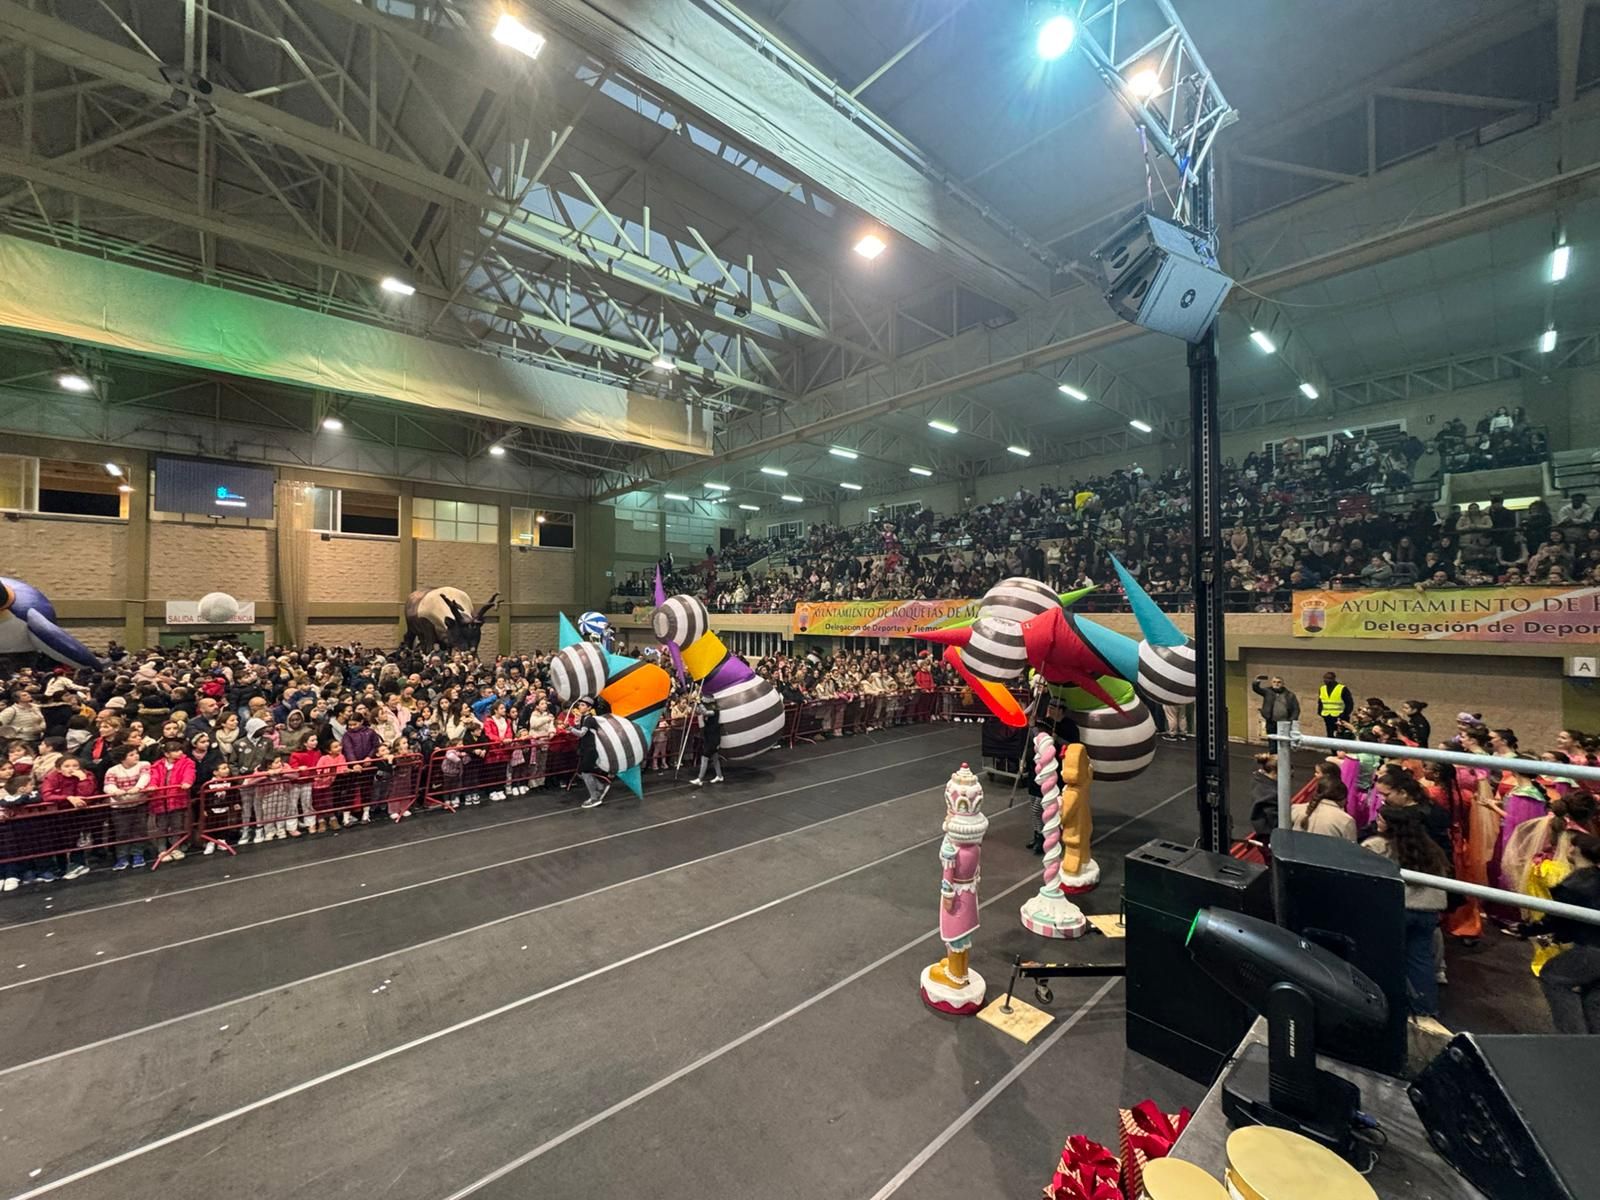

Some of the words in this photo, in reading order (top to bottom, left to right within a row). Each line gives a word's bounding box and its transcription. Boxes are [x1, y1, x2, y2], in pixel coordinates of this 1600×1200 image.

[1340, 598, 1531, 613] AYUNTAMIENTO
[1543, 597, 1580, 612] DE
[813, 606, 875, 618] AYUNTAMIENTO
[877, 607, 889, 618] DE
[891, 606, 944, 620] ROQUETAS
[947, 606, 961, 618] DE
[873, 624, 905, 633] Deportes
[906, 625, 912, 633] y
[1364, 620, 1479, 634] Delegación
[1487, 621, 1515, 633] de
[1579, 662, 1591, 672] A
